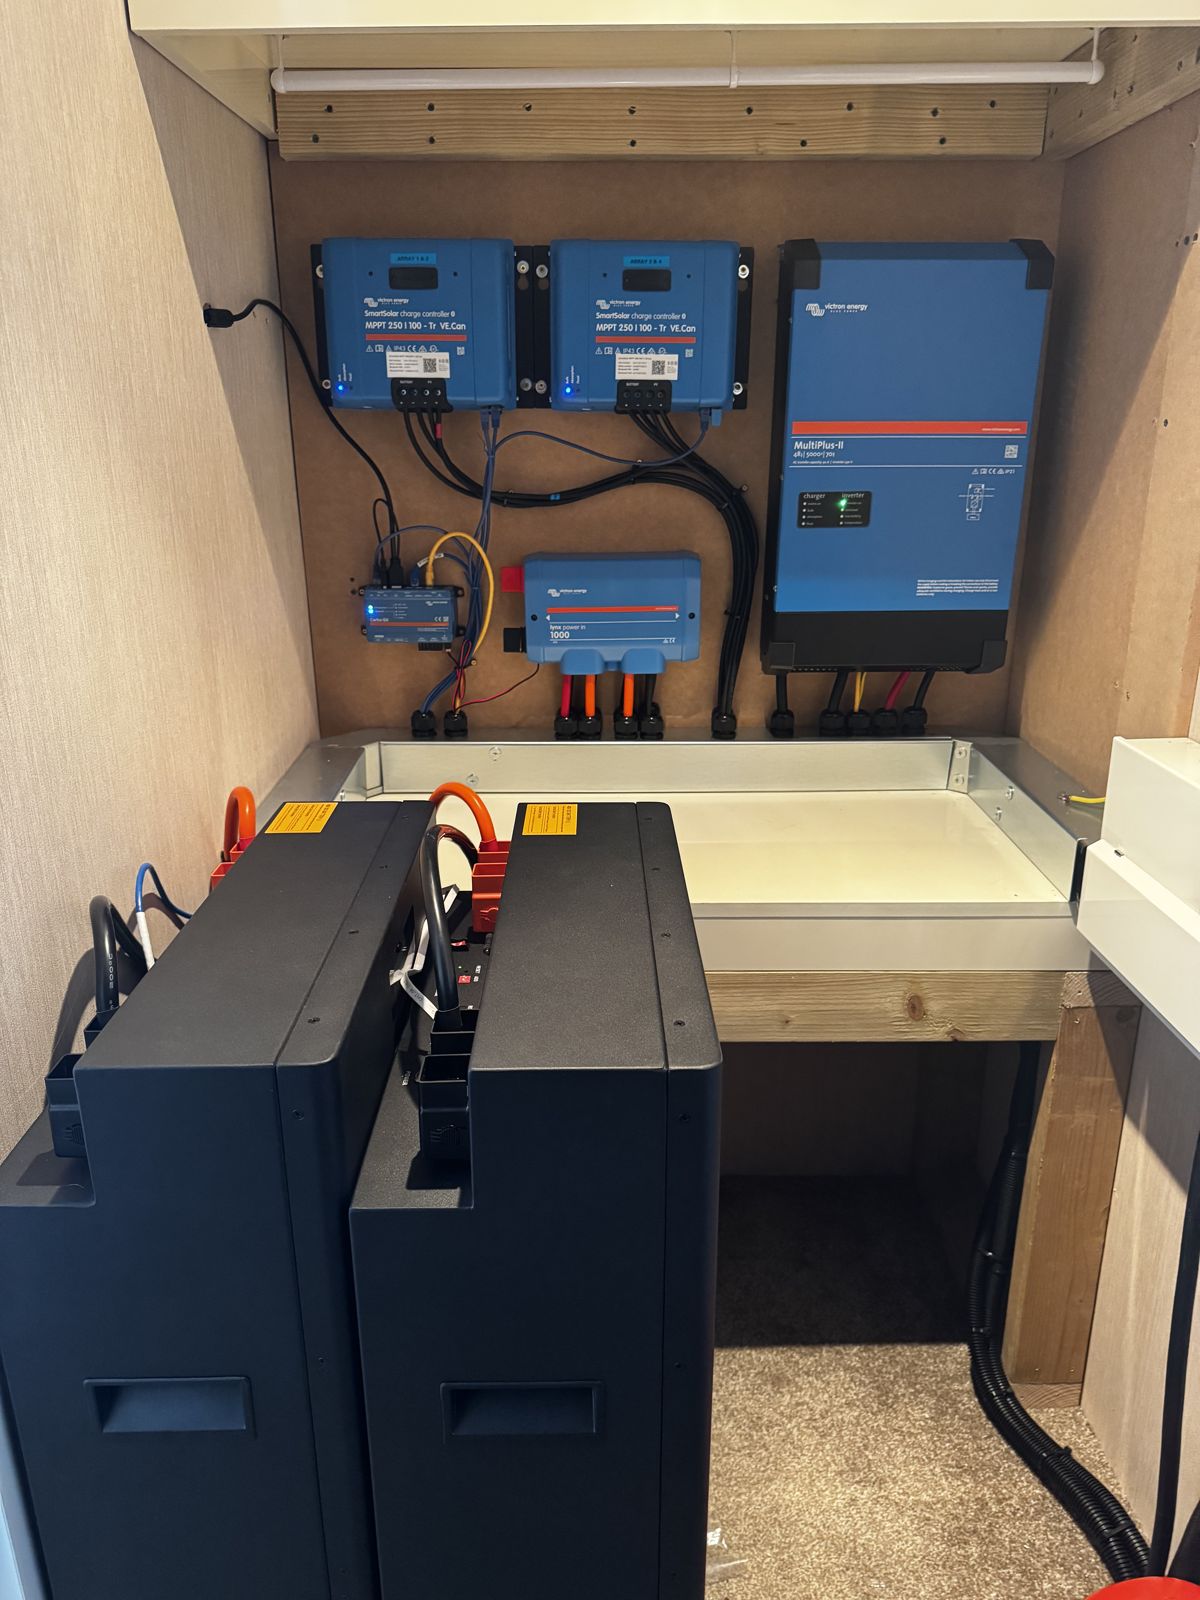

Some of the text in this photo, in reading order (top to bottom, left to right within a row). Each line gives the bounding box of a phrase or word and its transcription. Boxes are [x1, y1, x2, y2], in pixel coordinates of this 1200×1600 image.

[399, 311, 421, 319] charge
[631, 313, 652, 321] charge
[365, 321, 386, 329] MPPT
[388, 321, 403, 330] 250
[408, 321, 422, 330] 100
[428, 322, 437, 330] Tr
[439, 322, 467, 330] VE.Can
[595, 323, 617, 331] MPPT
[618, 323, 634, 332] 250
[639, 323, 653, 332] 100
[658, 324, 667, 332] Tr
[669, 324, 697, 333] VE.Can
[550, 631, 570, 639] 1000
